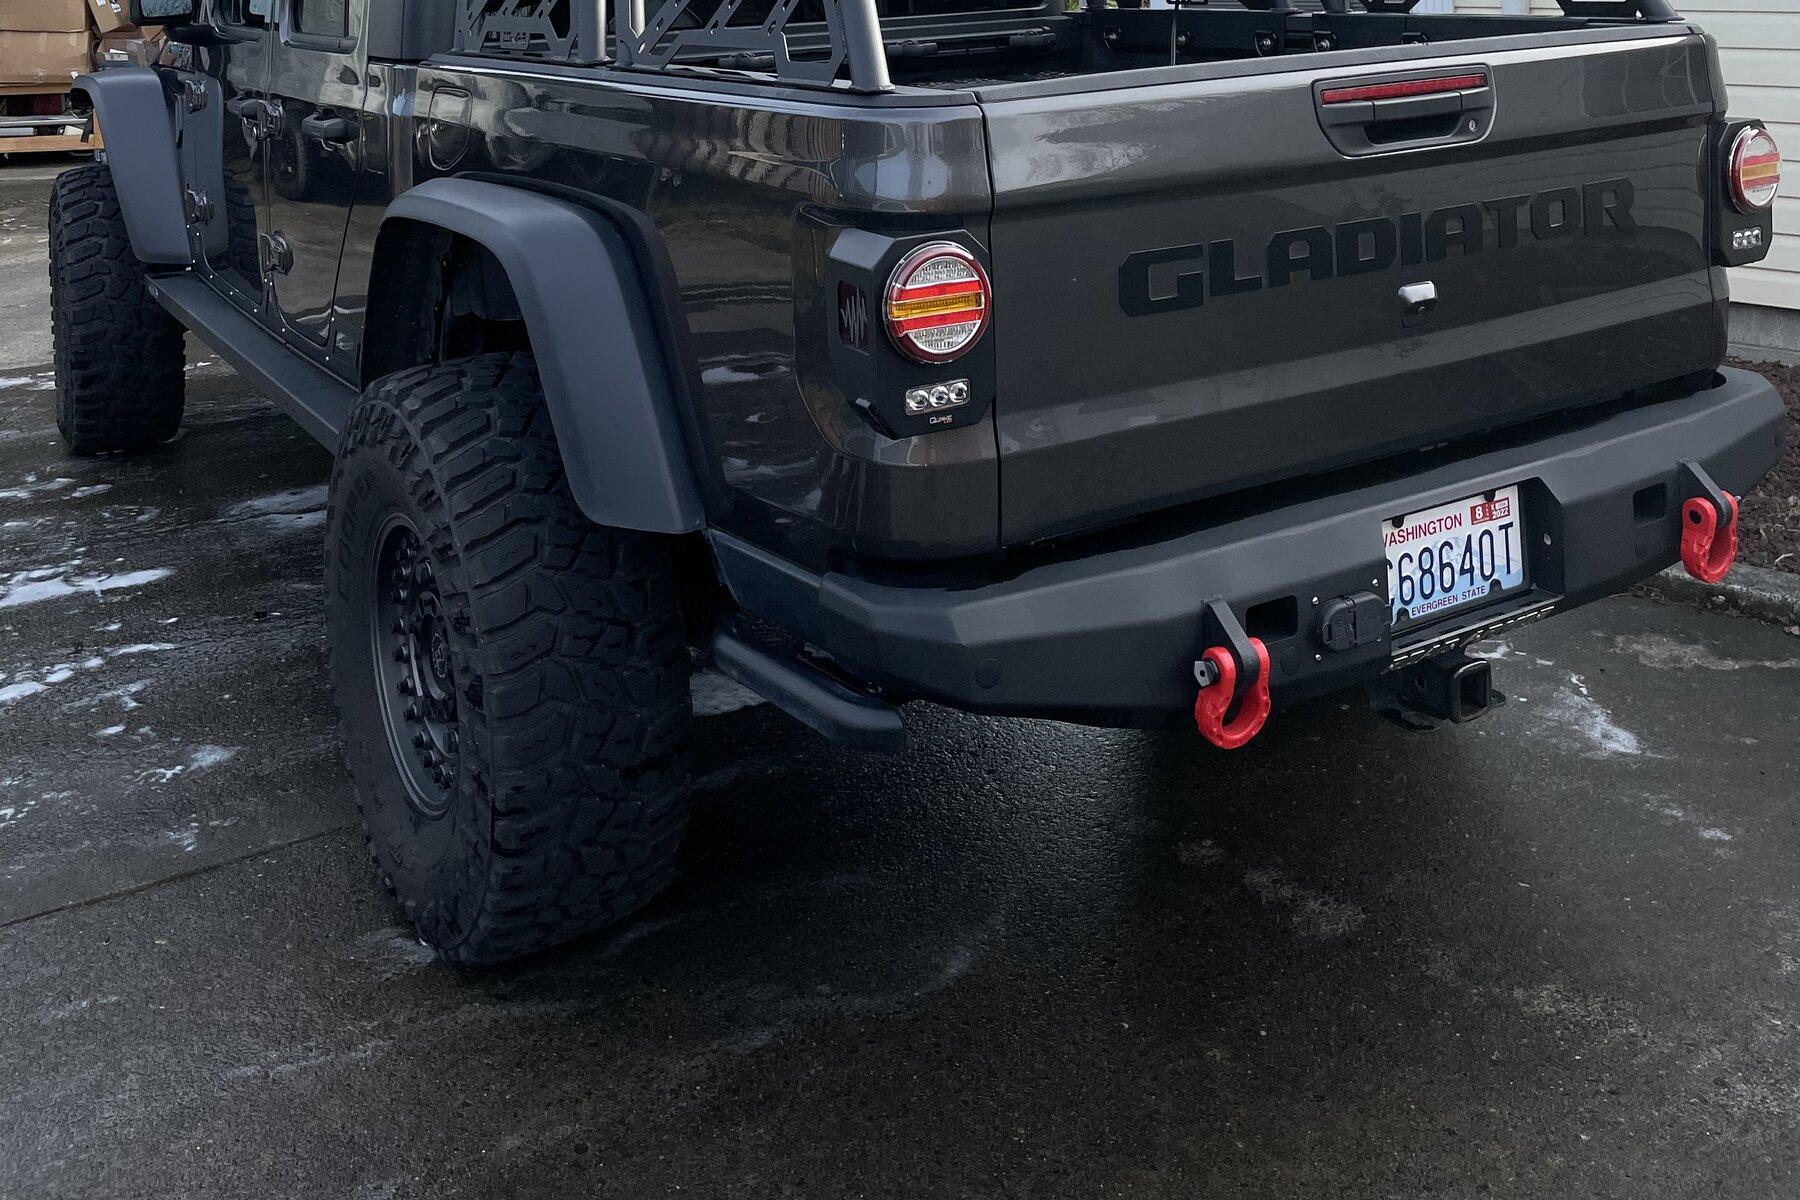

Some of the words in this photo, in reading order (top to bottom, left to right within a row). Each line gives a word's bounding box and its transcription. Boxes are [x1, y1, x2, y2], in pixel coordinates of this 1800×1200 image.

[1119, 177, 1637, 316] GLADIATOR
[1475, 505, 1483, 520] 8
[1491, 508, 1509, 519] 2022
[1384, 513, 1462, 547] ASHINGTON
[1412, 595, 1458, 616] EVERGREEN
[1462, 585, 1486, 599] STATE
